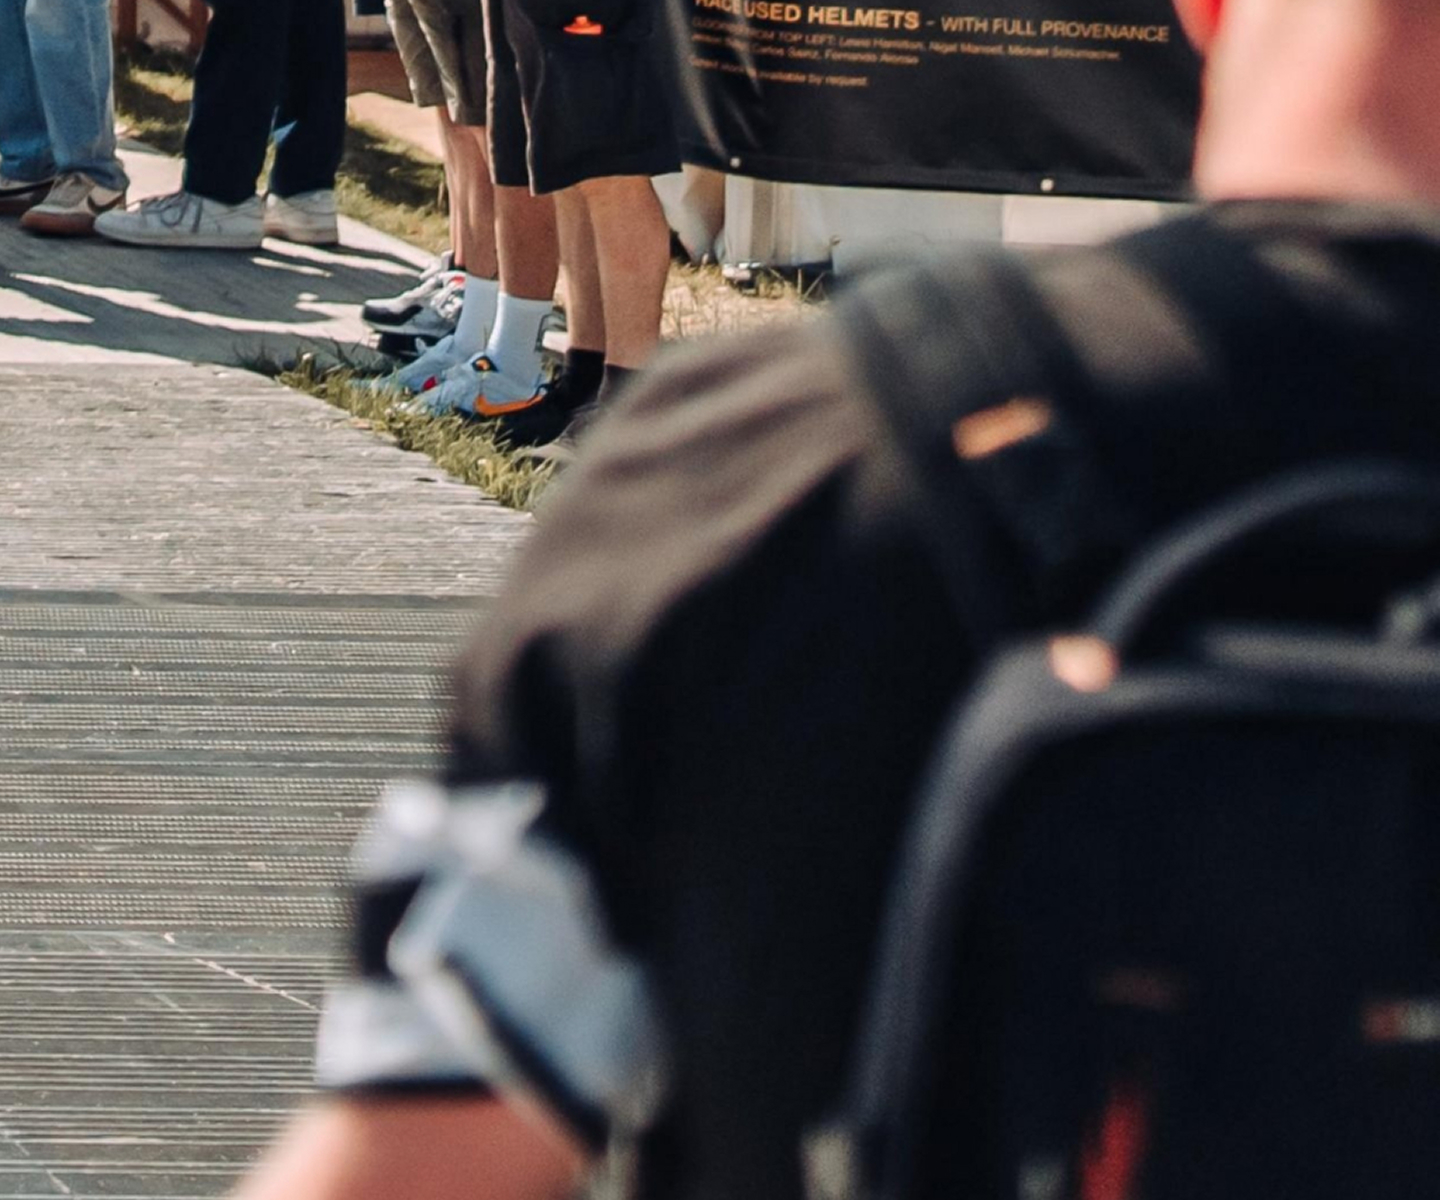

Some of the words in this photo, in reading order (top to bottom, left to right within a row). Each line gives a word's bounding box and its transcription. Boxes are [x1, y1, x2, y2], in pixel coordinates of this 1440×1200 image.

[808, 5, 920, 31] HELMETS
[941, 16, 988, 33] WITH
[992, 18, 1036, 36] FULL
[1041, 19, 1170, 43] PROVENANCE
